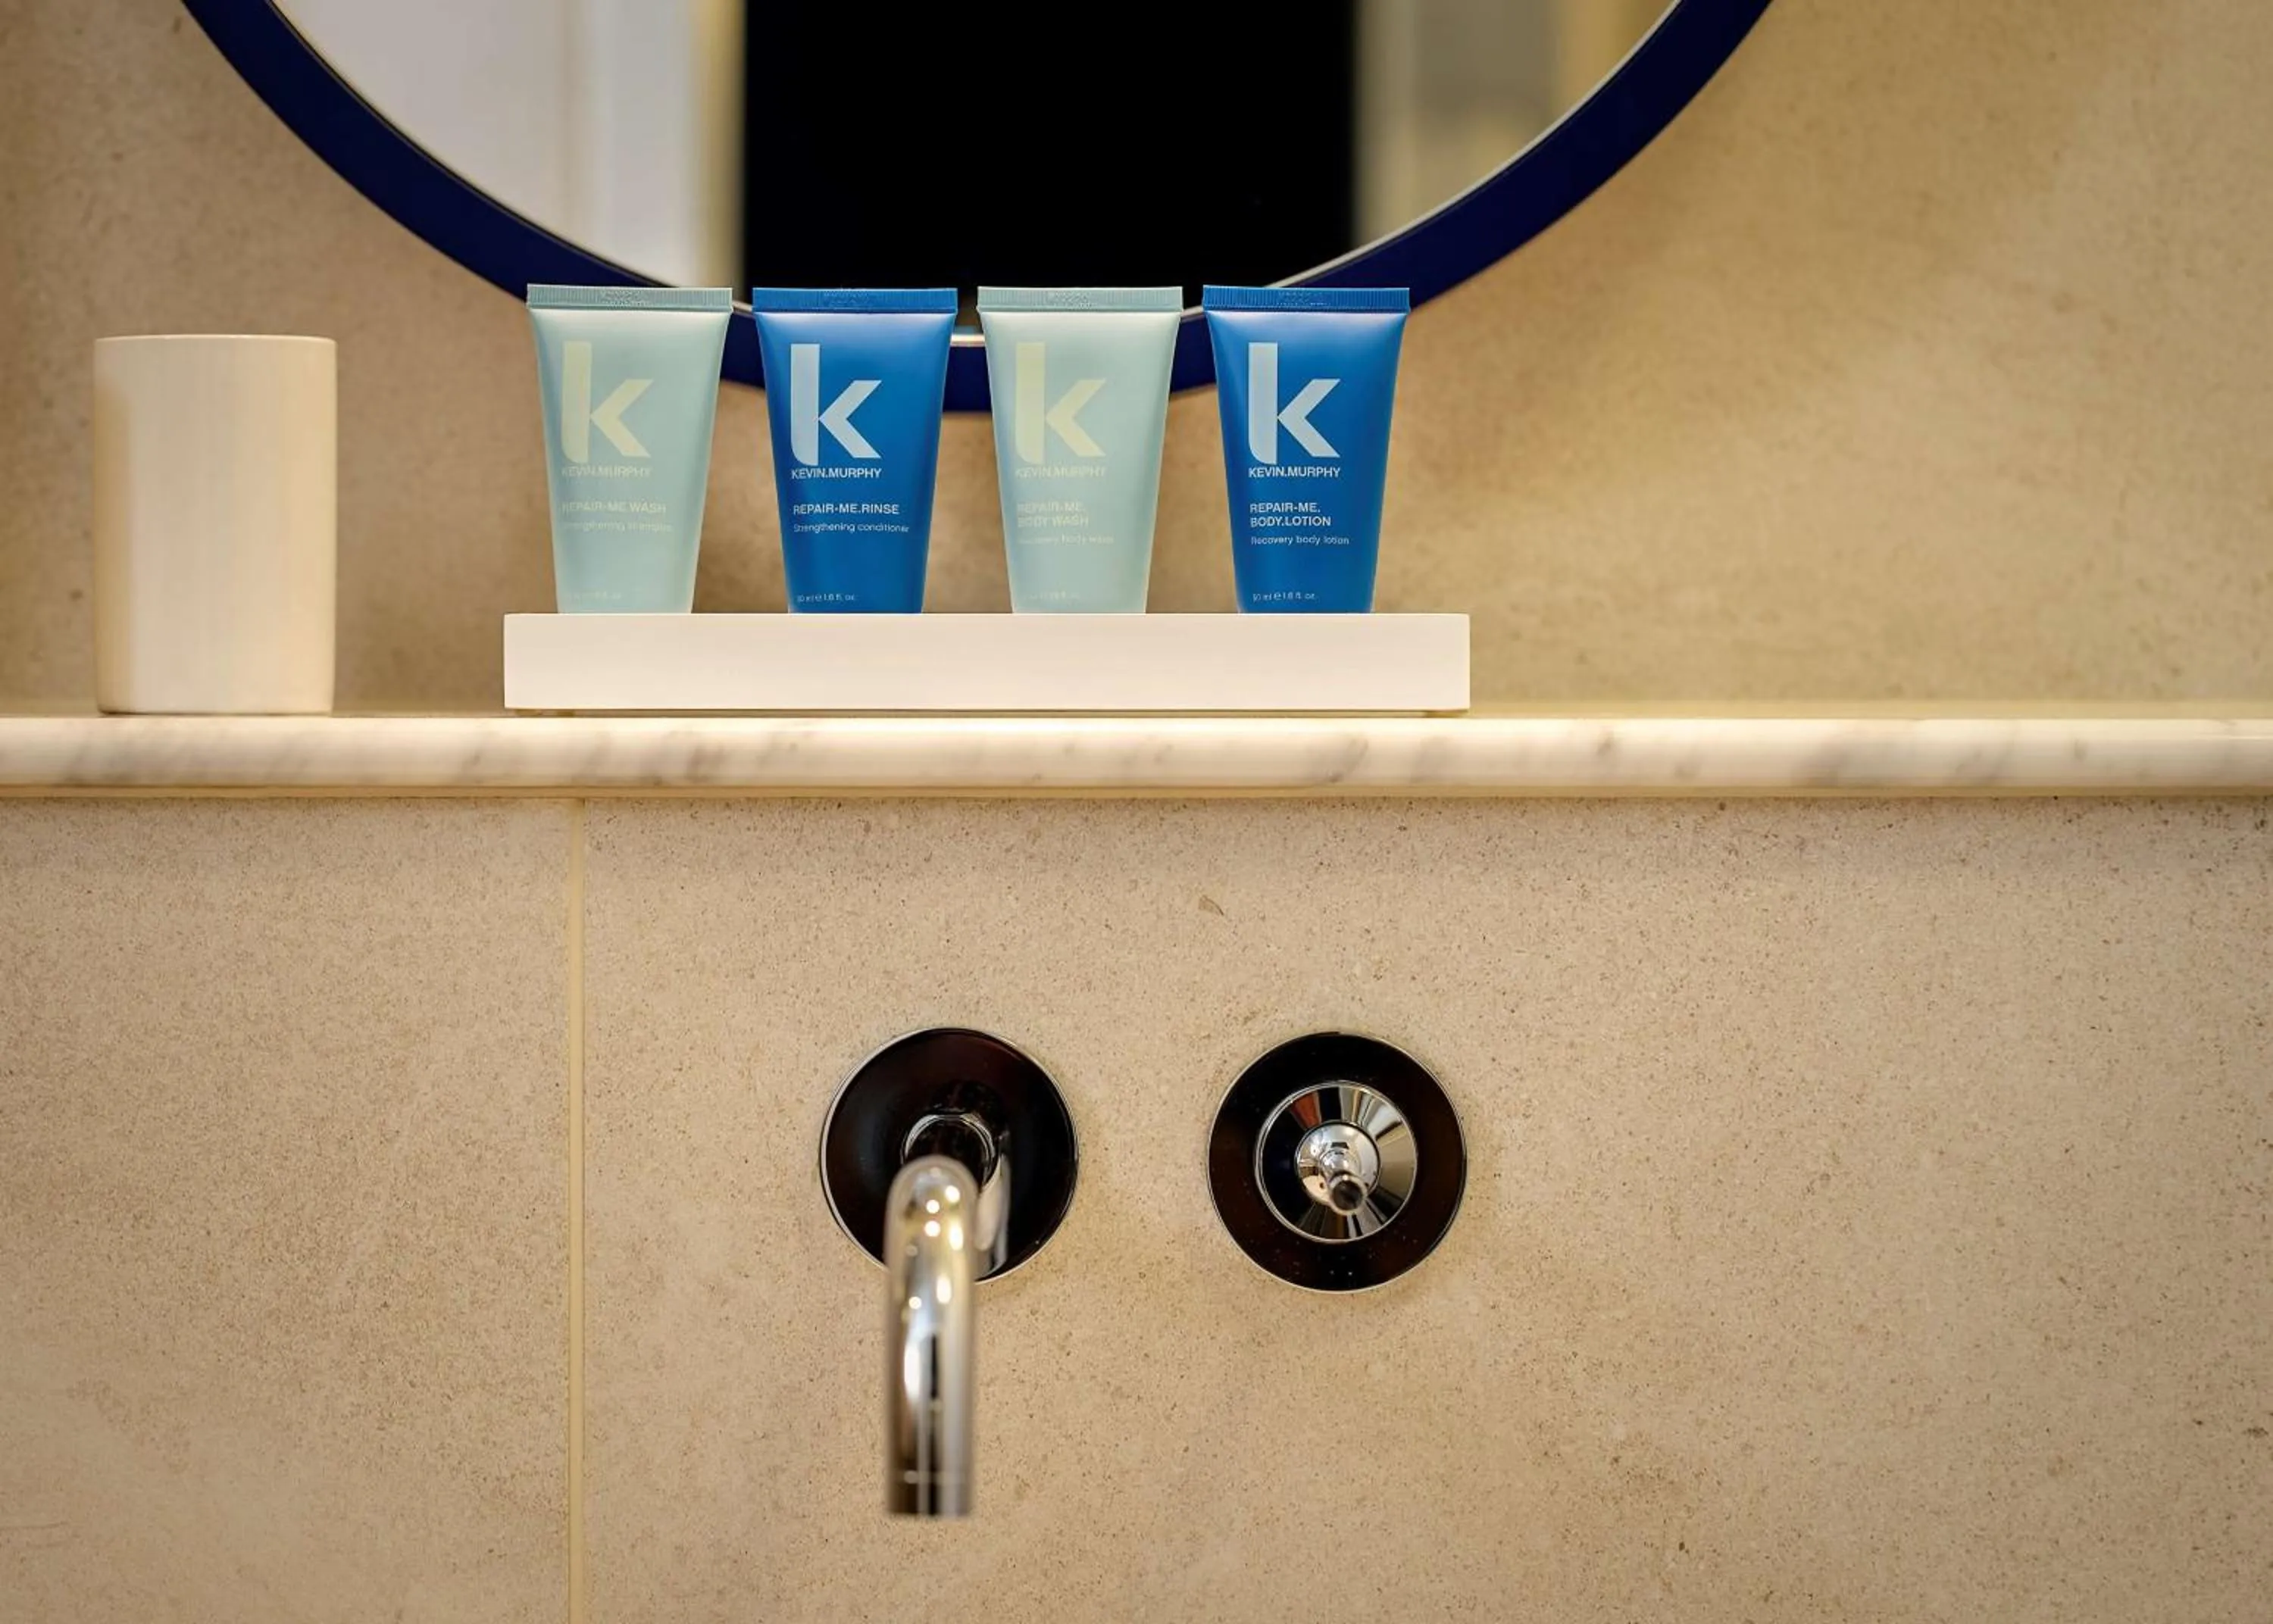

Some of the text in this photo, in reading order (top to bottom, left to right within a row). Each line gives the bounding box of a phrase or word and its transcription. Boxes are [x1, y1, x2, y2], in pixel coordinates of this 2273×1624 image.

[792, 467, 882, 479] KEVIN.MURPHY
[1249, 466, 1340, 478] KEVIN.MURPHY
[793, 503, 900, 515] REPAIR-ME.RINSE
[1250, 502, 1321, 514] REPAIR-ME.
[1250, 516, 1331, 528] BODY.LOTION
[1251, 536, 1293, 545] Recovery
[1296, 535, 1320, 545] body
